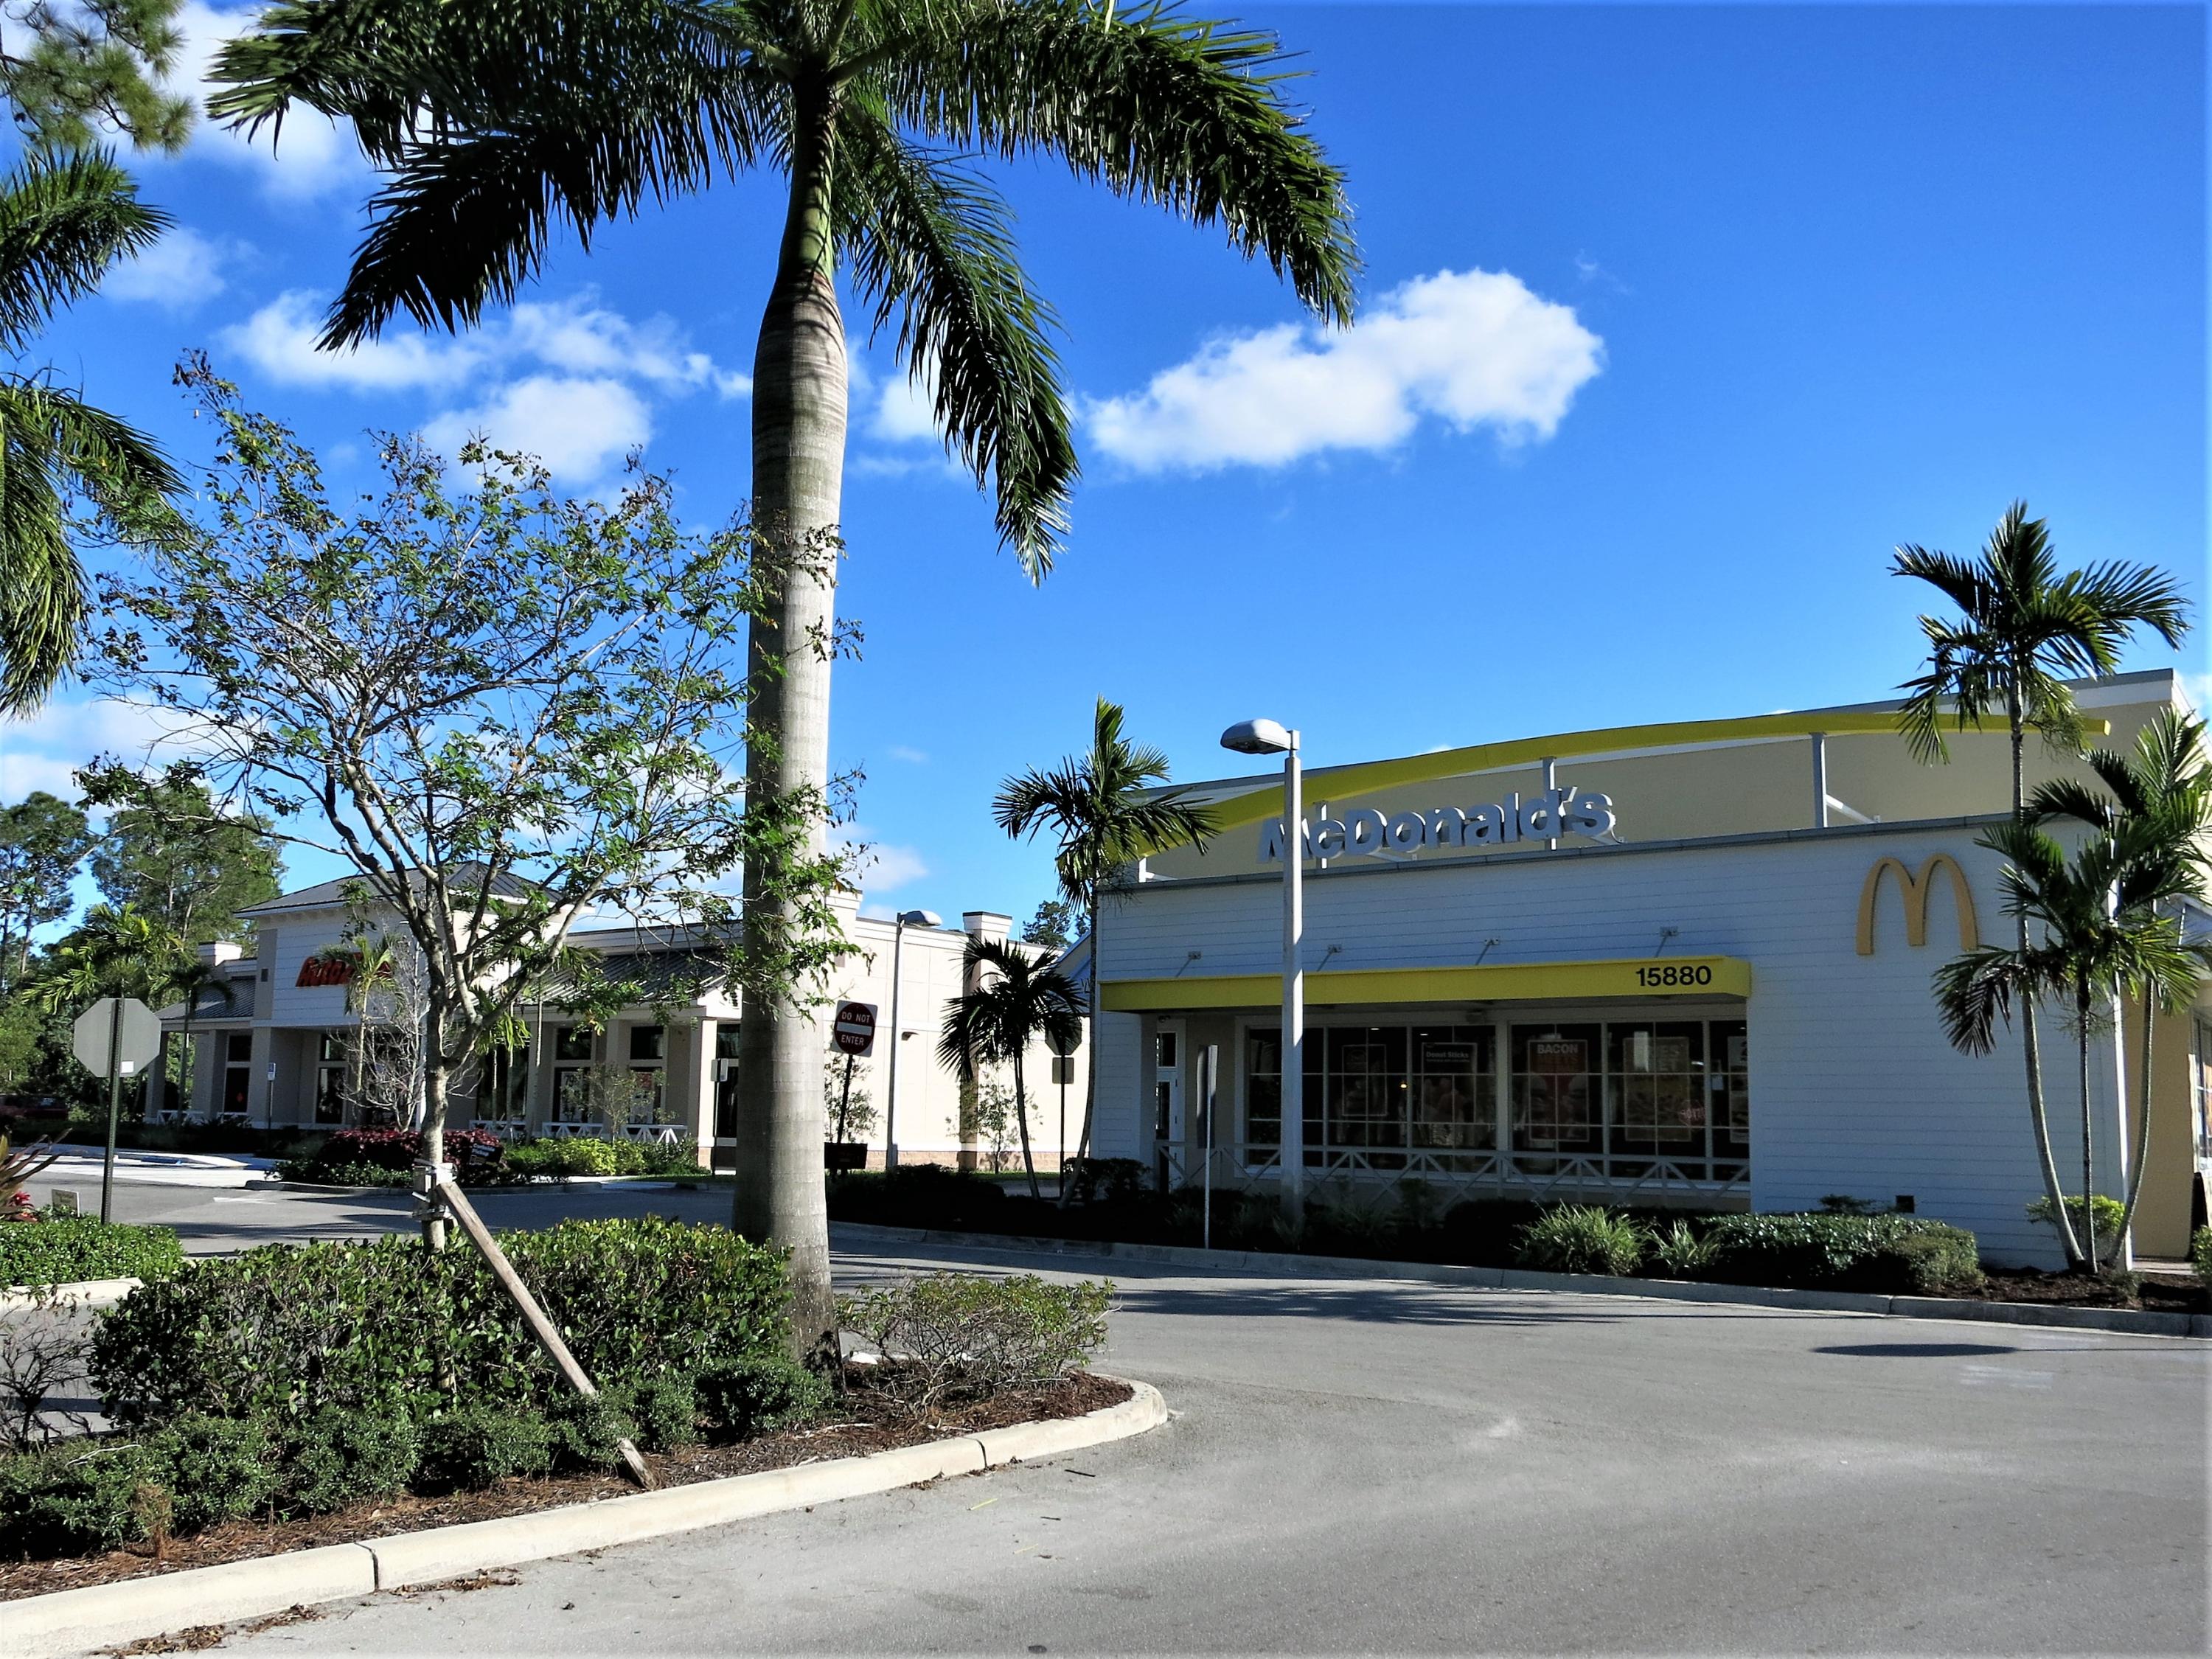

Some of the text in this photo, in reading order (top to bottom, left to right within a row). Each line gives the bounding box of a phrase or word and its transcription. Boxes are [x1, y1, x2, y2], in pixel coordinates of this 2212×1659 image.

[1258, 787, 1614, 863] McDonald's
[1635, 965, 1712, 987] 15880
[841, 1011, 871, 1023] DO NOT
[841, 1034, 865, 1046] ENTER
[1537, 1043, 1579, 1054] BACON
[1447, 1051, 1470, 1059] Sticks
